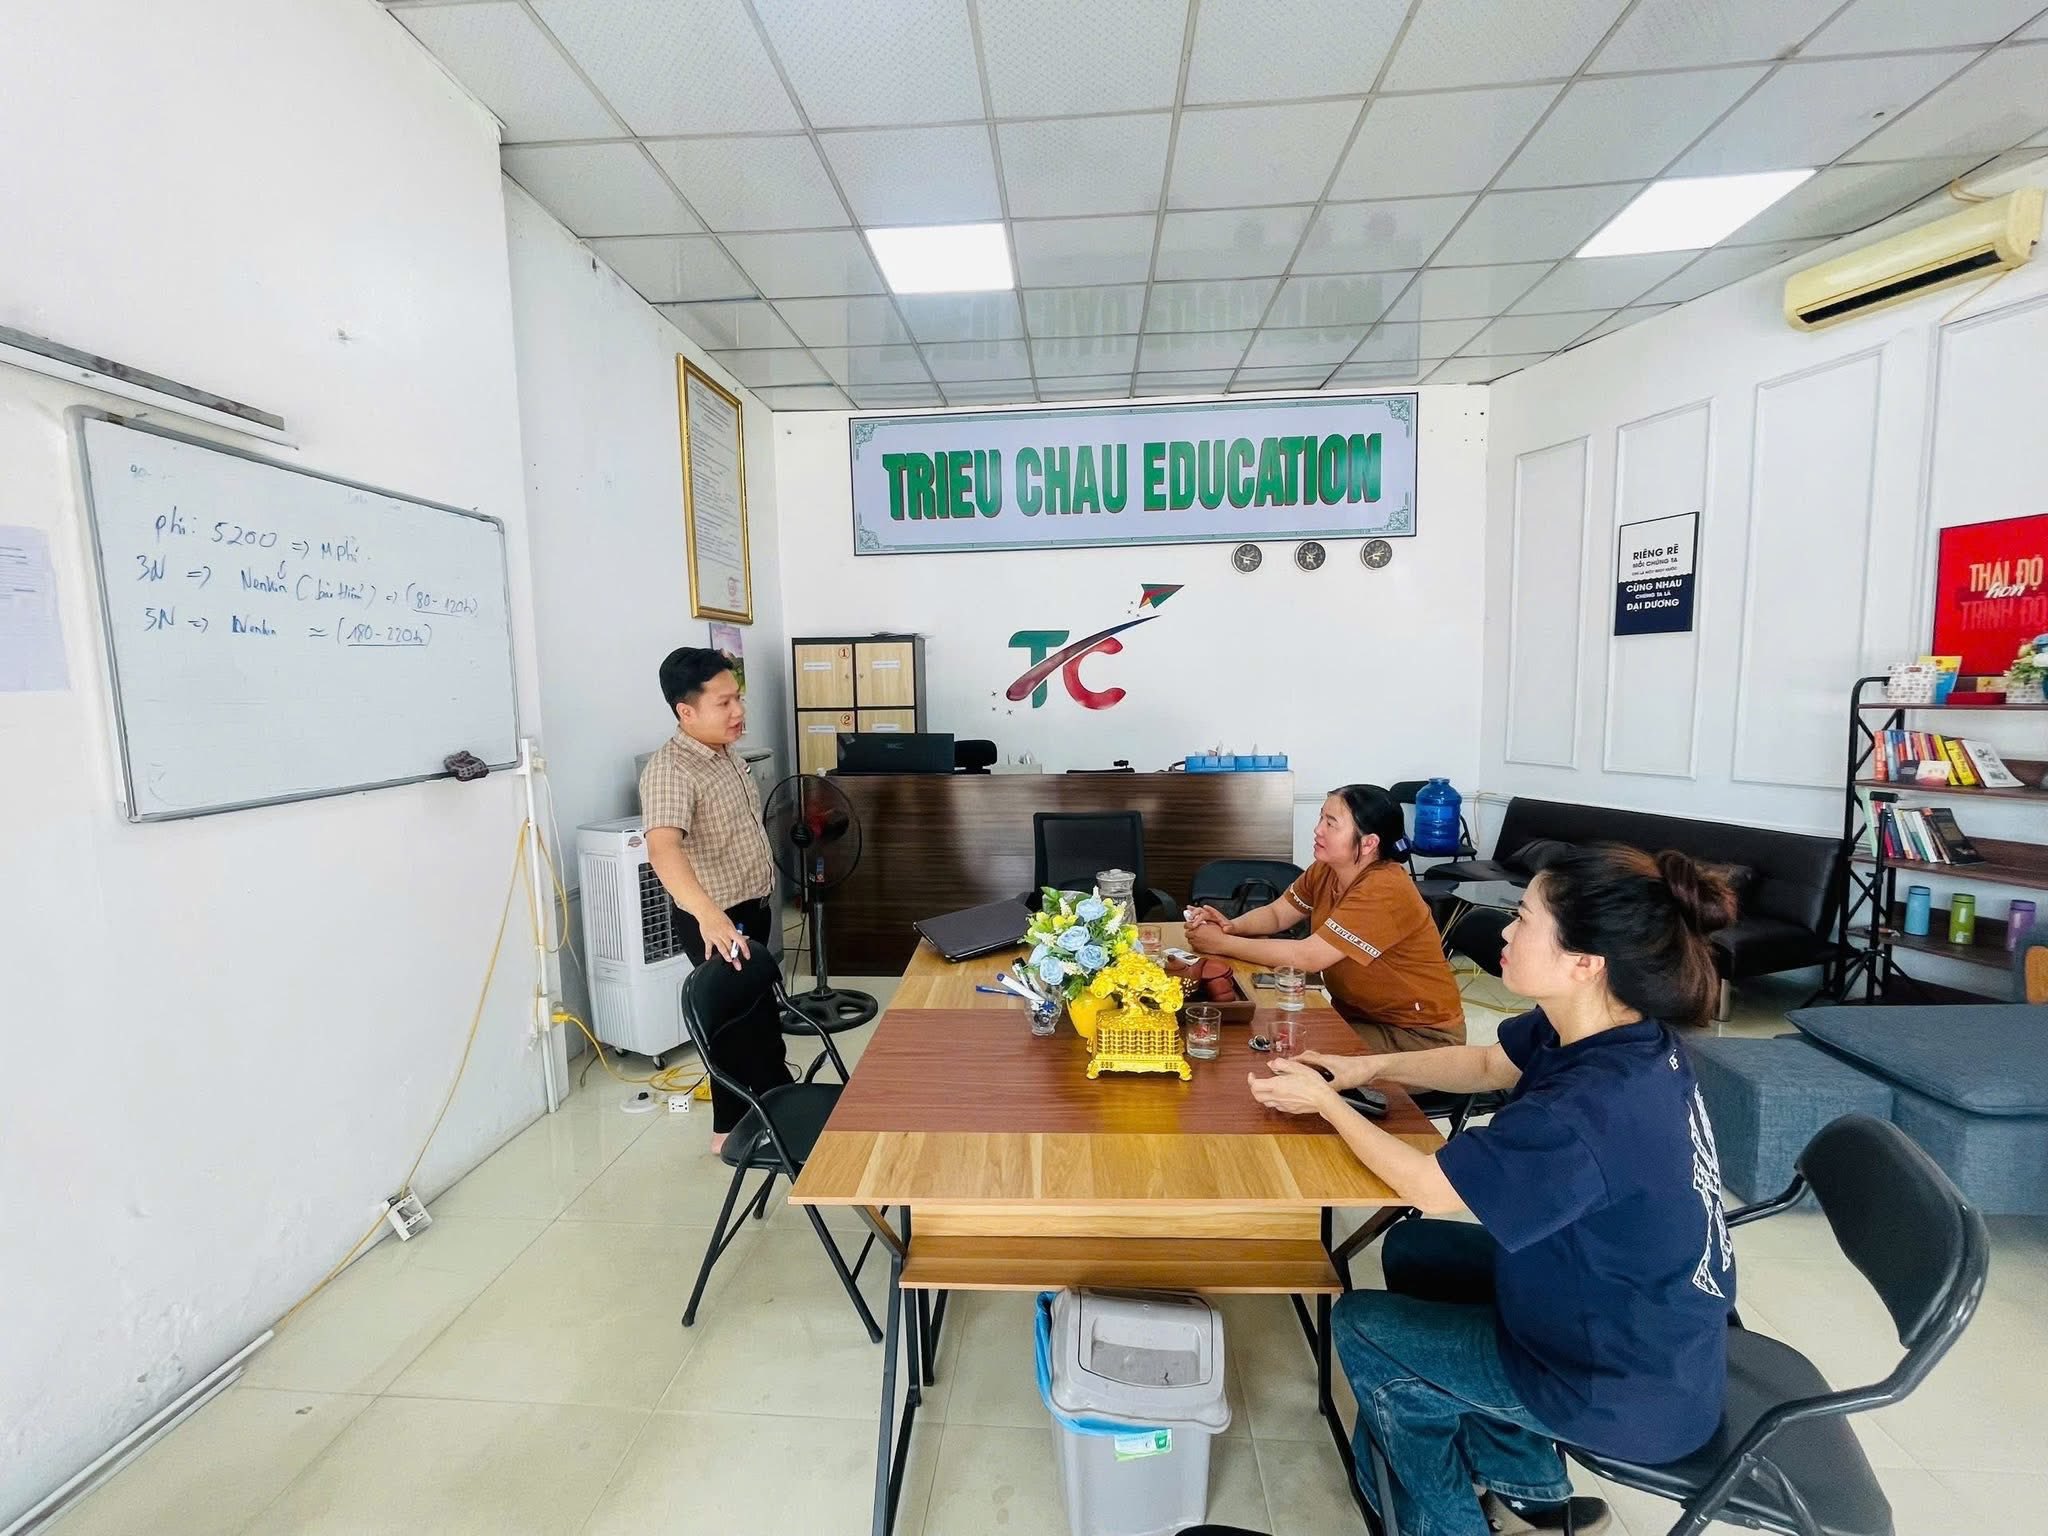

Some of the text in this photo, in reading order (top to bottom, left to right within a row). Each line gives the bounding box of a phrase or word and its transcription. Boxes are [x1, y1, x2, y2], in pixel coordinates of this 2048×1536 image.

[882, 432, 1383, 521] TRIEU CHAU EDUCATION
[212, 521, 277, 548] 5200
[1633, 548, 1664, 560] RIÊNG
[1626, 579, 1683, 593] CÙNG NHAU
[1644, 598, 1680, 609] DƯƠNG
